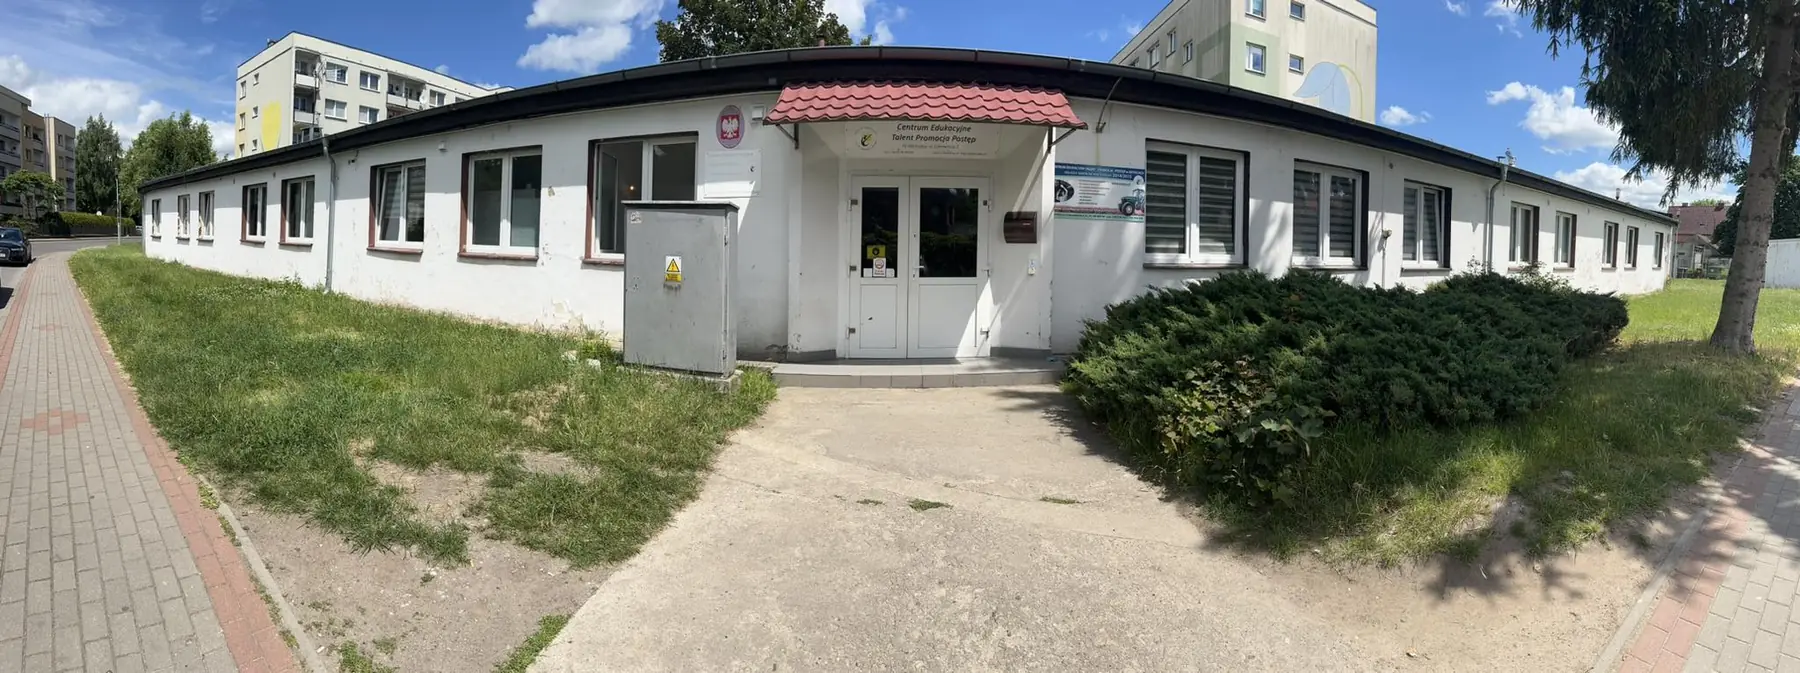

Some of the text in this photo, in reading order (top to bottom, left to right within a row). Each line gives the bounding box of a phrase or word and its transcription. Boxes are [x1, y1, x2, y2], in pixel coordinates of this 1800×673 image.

[896, 123, 972, 133] Centrum Edukacyjne
[892, 133, 977, 144] Talent Promocja Postęp
